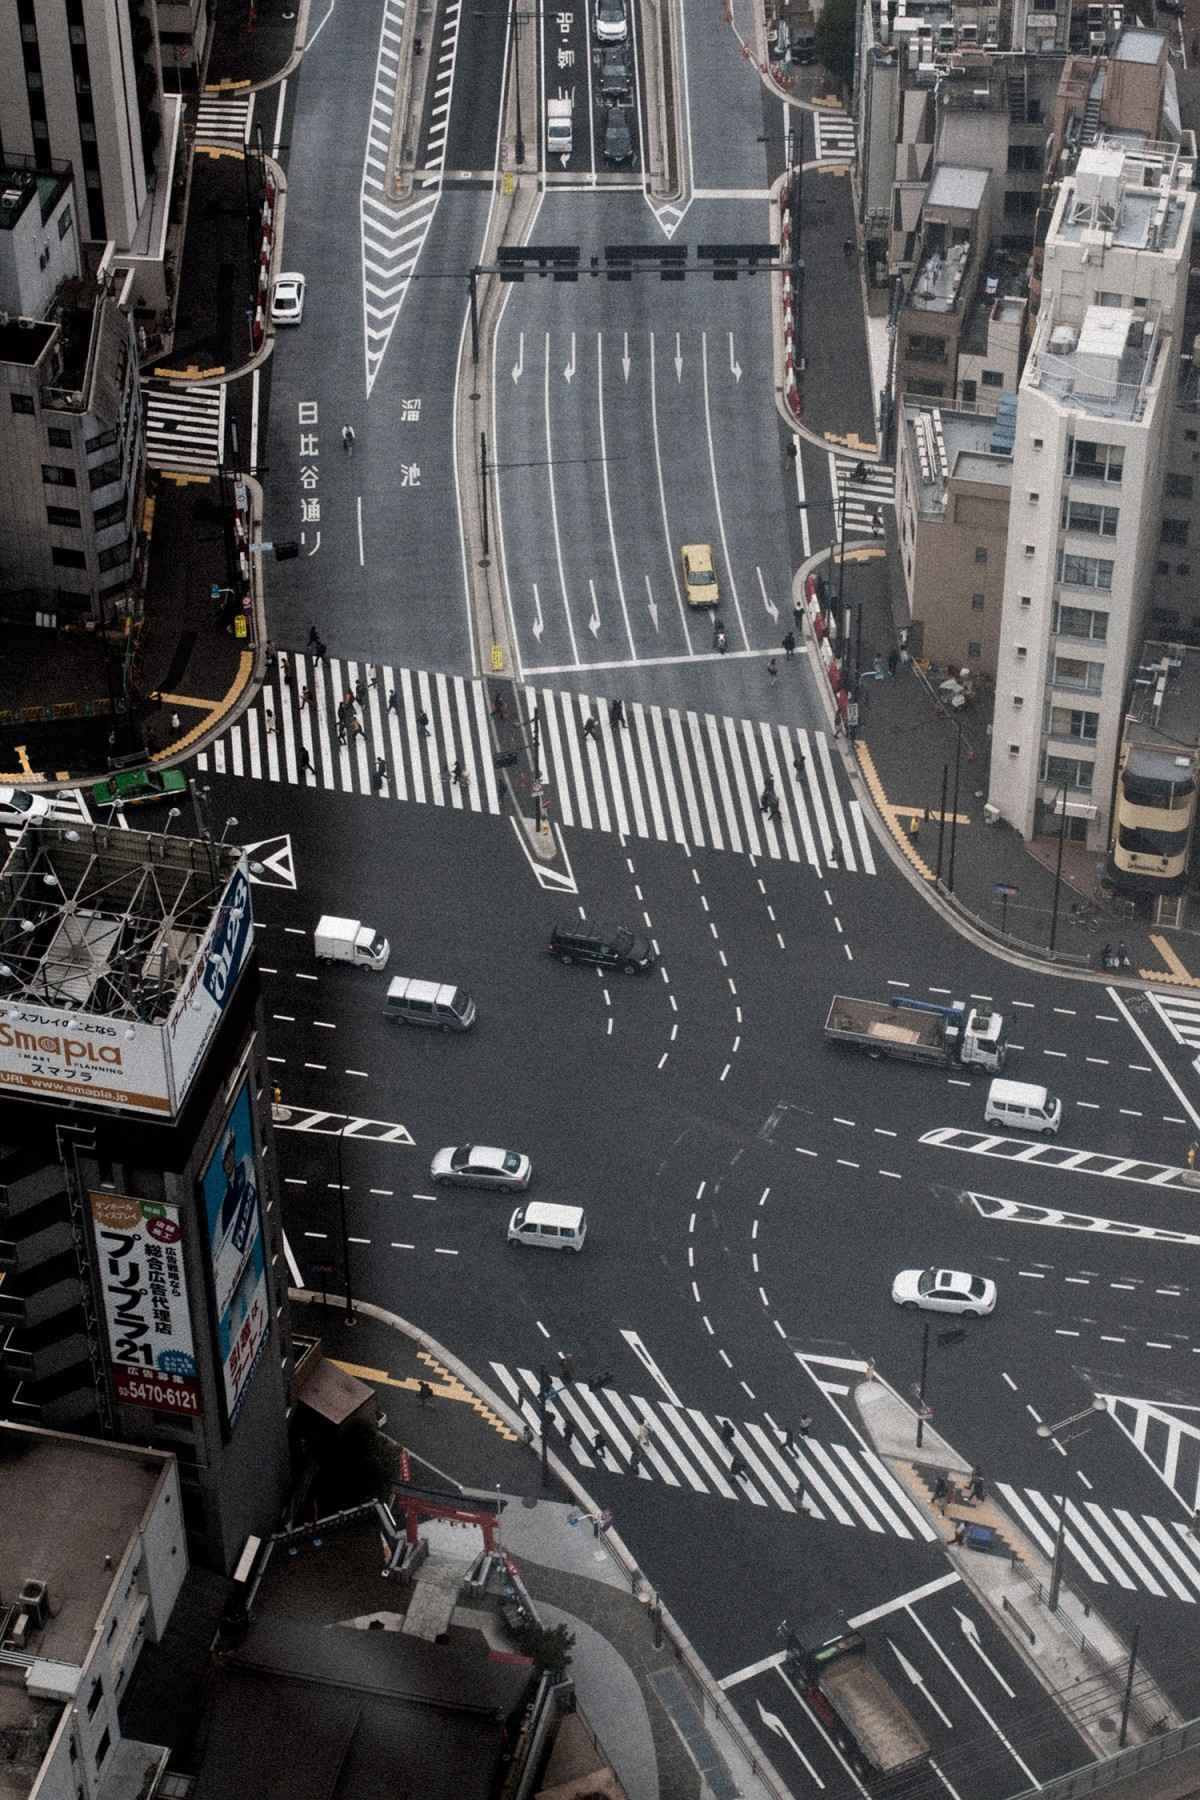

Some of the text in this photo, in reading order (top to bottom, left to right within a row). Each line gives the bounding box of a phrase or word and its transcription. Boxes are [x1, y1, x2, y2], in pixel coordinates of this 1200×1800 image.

[298, 401, 321, 556] 日比谷通り
[0, 1072, 129, 1102] URL www.smapla.jp
[74, 1062, 124, 1076] PLANNING
[144, 1243, 172, 1336] 総合広告代理店
[165, 1247, 181, 1297] 広告戦略なら
